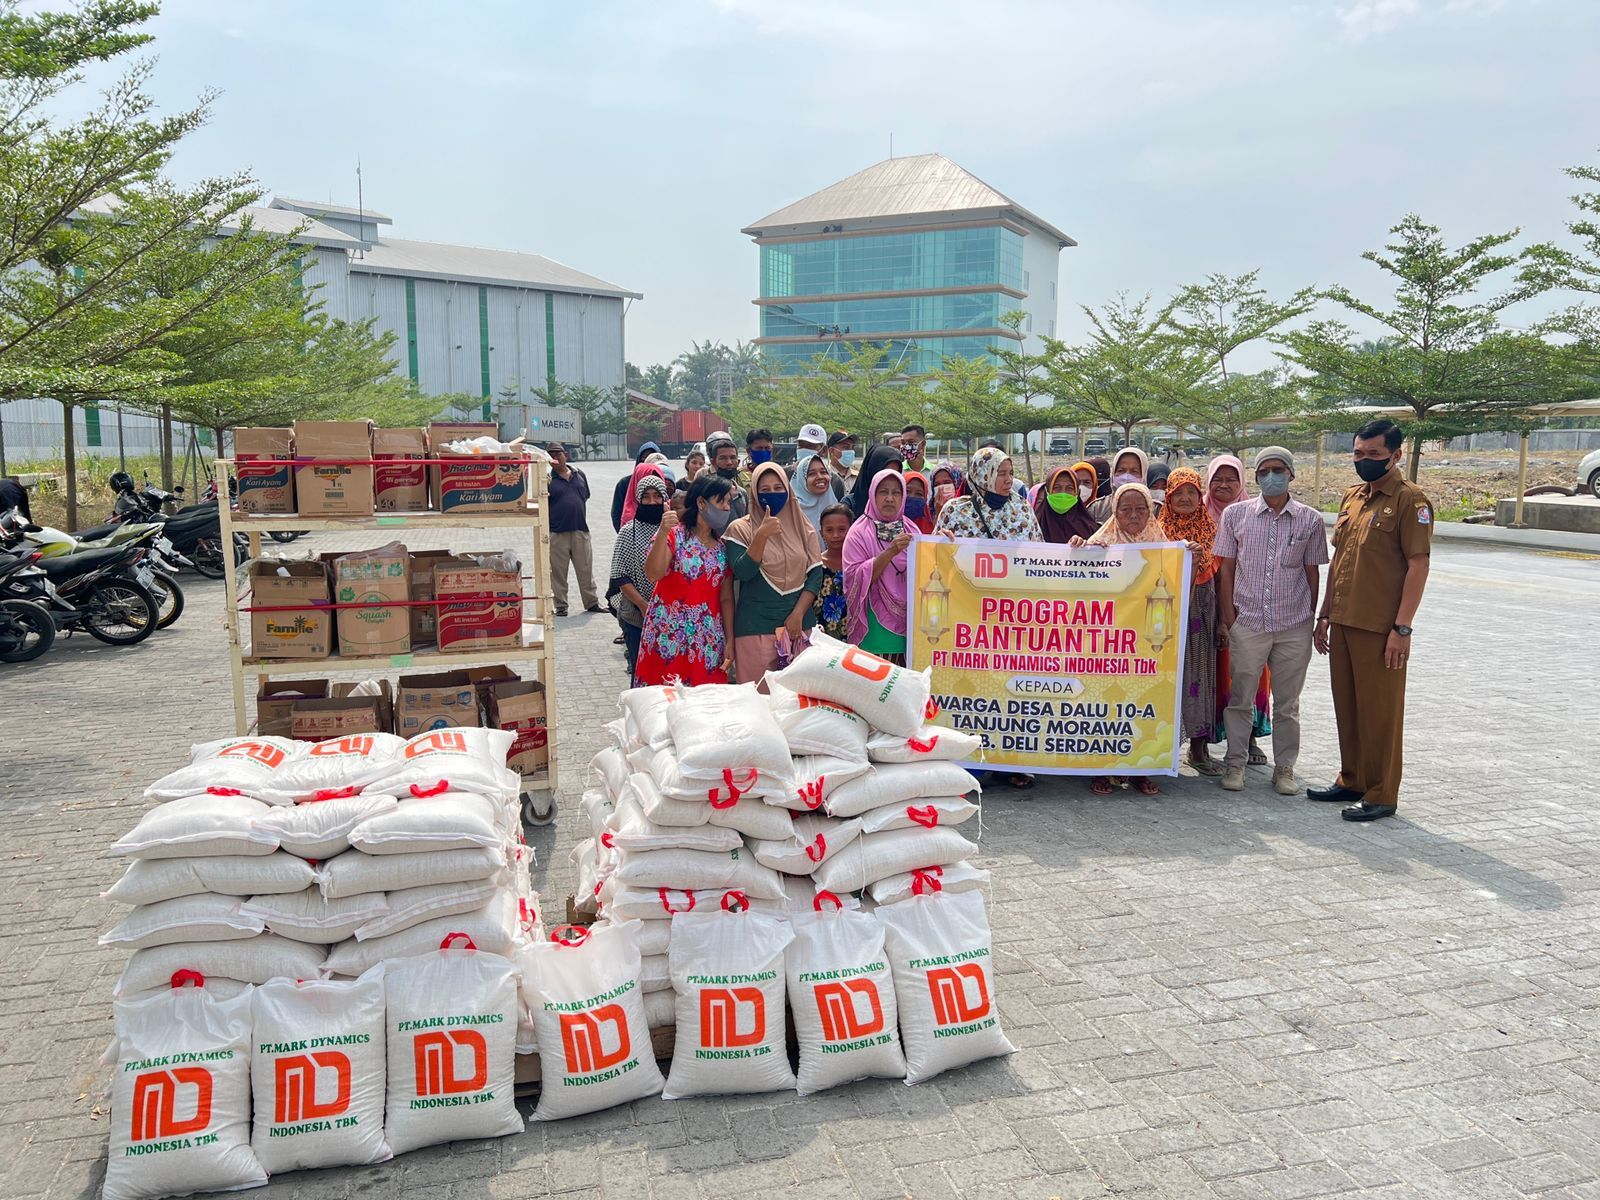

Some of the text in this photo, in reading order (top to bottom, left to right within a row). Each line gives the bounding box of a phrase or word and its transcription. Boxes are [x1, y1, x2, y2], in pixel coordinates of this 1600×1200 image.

[542, 420, 574, 430] MAERSK
[460, 494, 503, 504] Kari Ayam
[1013, 557, 1122, 568] PT MARK DYNAMICS
[1025, 569, 1086, 579] INDONESIA
[356, 608, 392, 622] Squash
[981, 597, 1114, 626] PROGRAM
[266, 621, 314, 634] Familie
[955, 624, 1136, 654] BANTUAN THR
[932, 651, 1157, 674] PT MARK DYNAMICS INDONESIA Tbk
[1015, 680, 1074, 694] KEPADA
[930, 695, 1156, 719] WARGA DESA DALU 10-A
[952, 714, 1134, 736] TANJUNG MORAWA
[1002, 736, 1038, 751] DELI
[1044, 738, 1132, 754] SERDANG
[951, 947, 990, 964] DYNAMICS
[730, 970, 777, 984] DYNAMICS
[841, 962, 886, 978] DYNAMICS
[586, 979, 636, 1008] DYNAMICS
[446, 1013, 504, 1026] DYNAMICS
[933, 1018, 996, 1039] INDONESIA TBK
[310, 1034, 370, 1049] DYNAMICS
[821, 1033, 892, 1054] INDONESIA TBK
[170, 1049, 234, 1065] DYNAMICS
[695, 1046, 772, 1060] INDONESIA TBK
[562, 1057, 640, 1087] INDONESIA TBK
[410, 1091, 496, 1110] INDONESIA TBK
[268, 1116, 359, 1138] INDONESIA TBK
[124, 1132, 219, 1156] INDONESIA TBK
